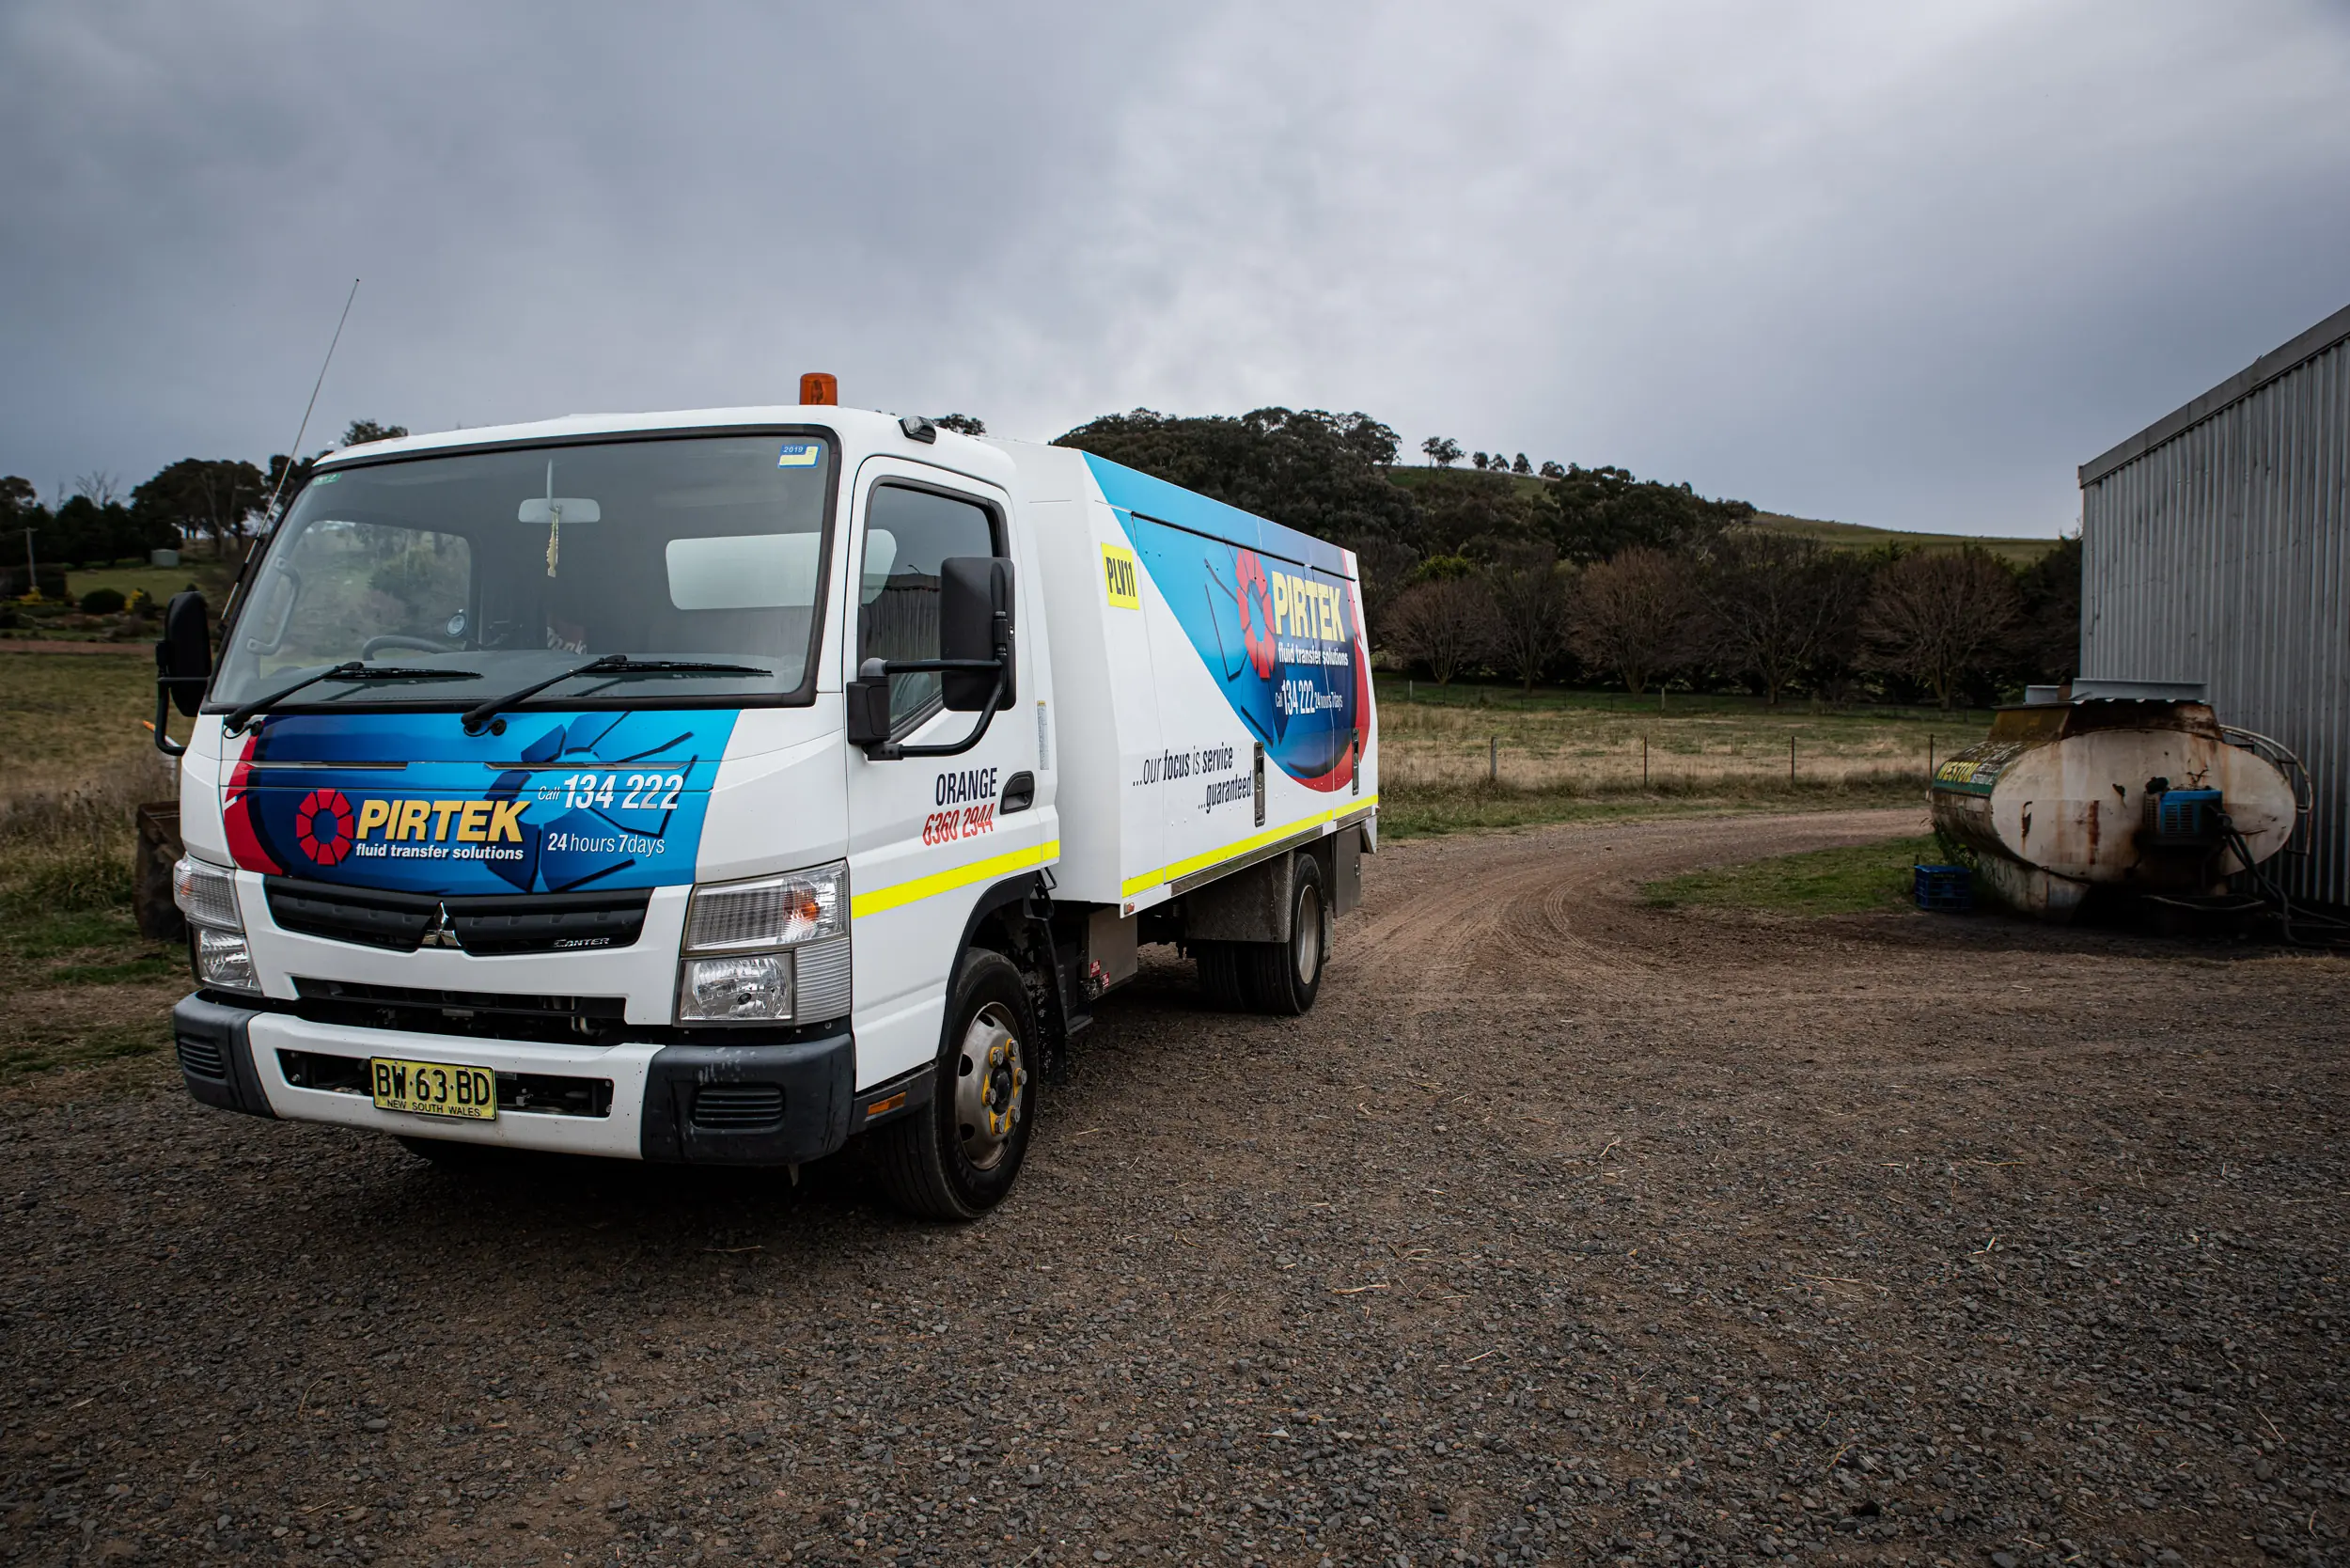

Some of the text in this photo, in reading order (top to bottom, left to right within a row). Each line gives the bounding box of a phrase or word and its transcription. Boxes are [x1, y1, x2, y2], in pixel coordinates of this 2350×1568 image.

[1105, 557, 1136, 597] PLV11
[1272, 571, 1346, 642] PIRTEK
[1278, 641, 1349, 666] fluid transfer solutions
[1281, 680, 1299, 715] 134
[1298, 680, 1316, 714] 222
[1163, 748, 1190, 780] focus
[1192, 745, 1199, 776] is
[1202, 742, 1233, 774] service
[538, 774, 684, 810] Call 134 222
[935, 767, 997, 807] ORANGE
[355, 799, 531, 842] PIRTEK
[922, 803, 995, 846] 6360 2944
[355, 843, 524, 860] fluid transfer solutions
[547, 833, 567, 851] 24
[570, 833, 616, 853] hours
[554, 937, 610, 948] CANTER
[386, 1099, 480, 1117] NEW SOUTH WALES
